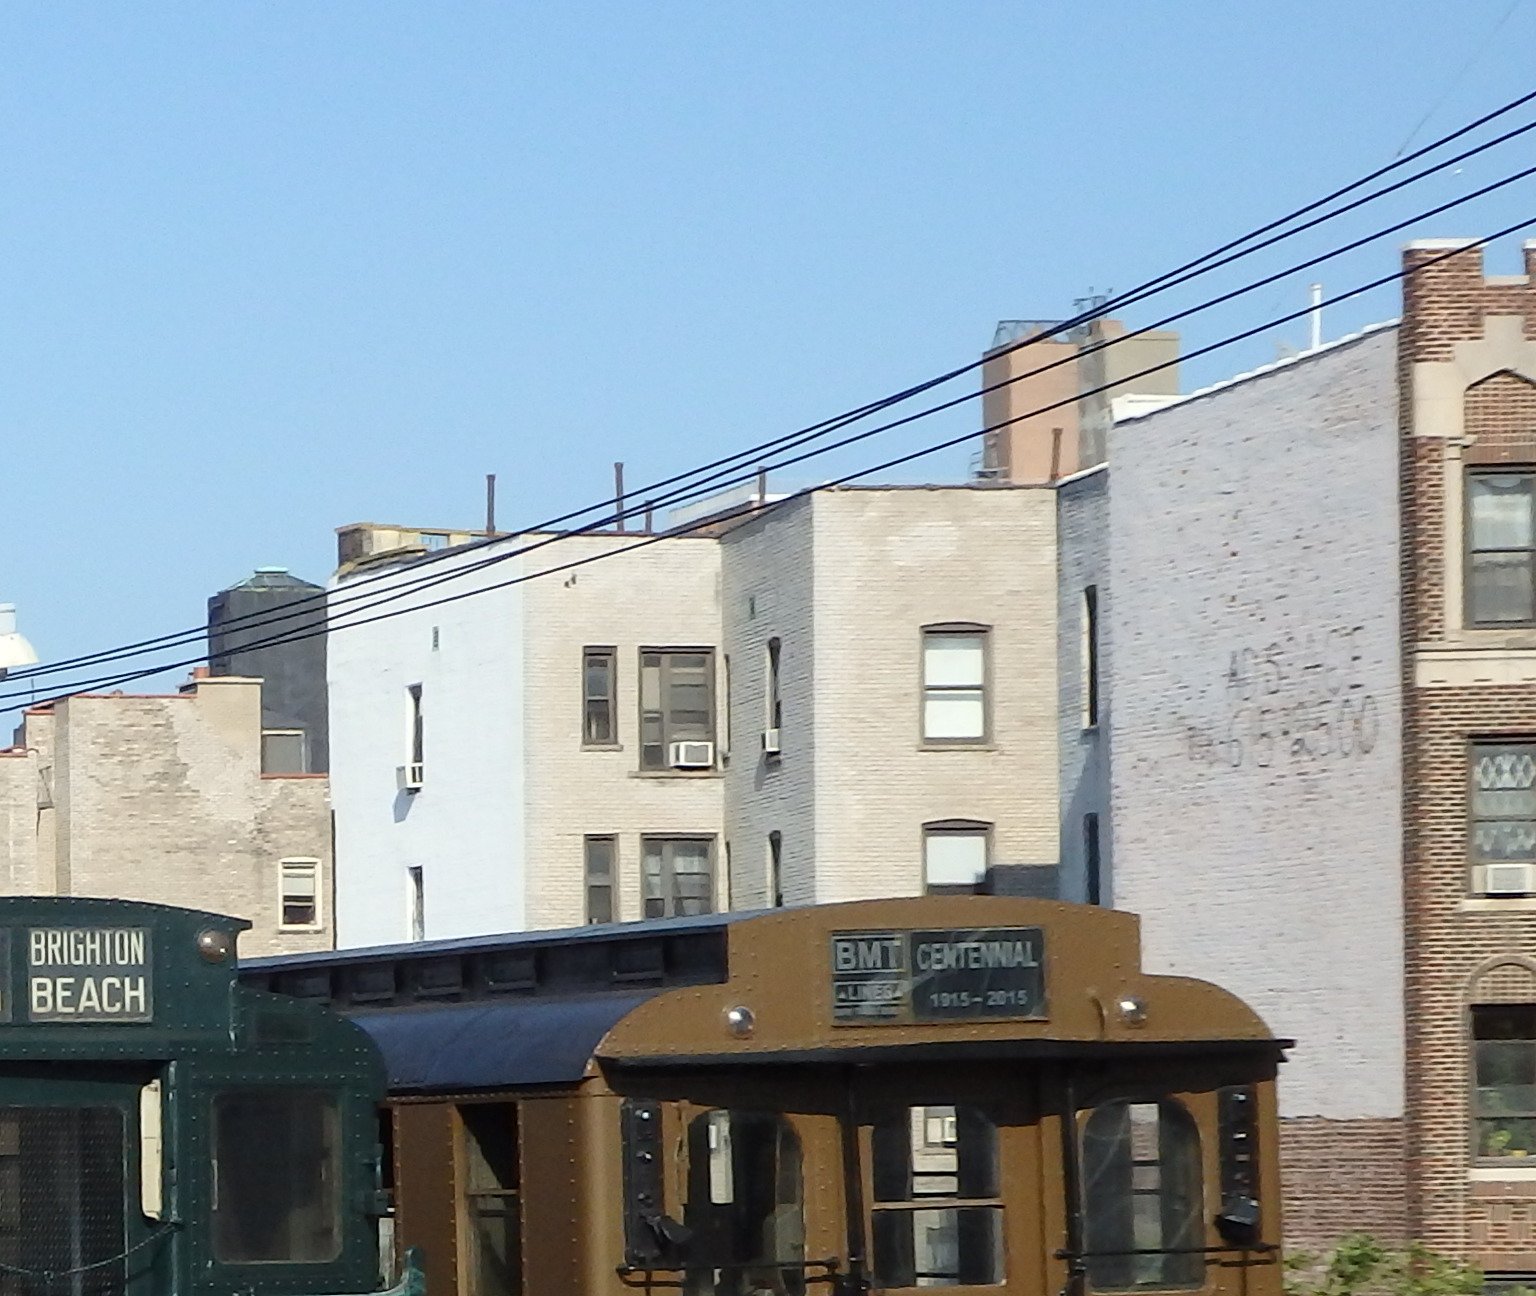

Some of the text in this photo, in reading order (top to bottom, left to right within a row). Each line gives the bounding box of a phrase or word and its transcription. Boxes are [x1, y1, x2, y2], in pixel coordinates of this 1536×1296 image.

[31, 930, 145, 966] BRIGHTON
[836, 941, 901, 970] BMT
[916, 940, 1039, 971] CENTENNIAL
[31, 976, 146, 1013] BEACH
